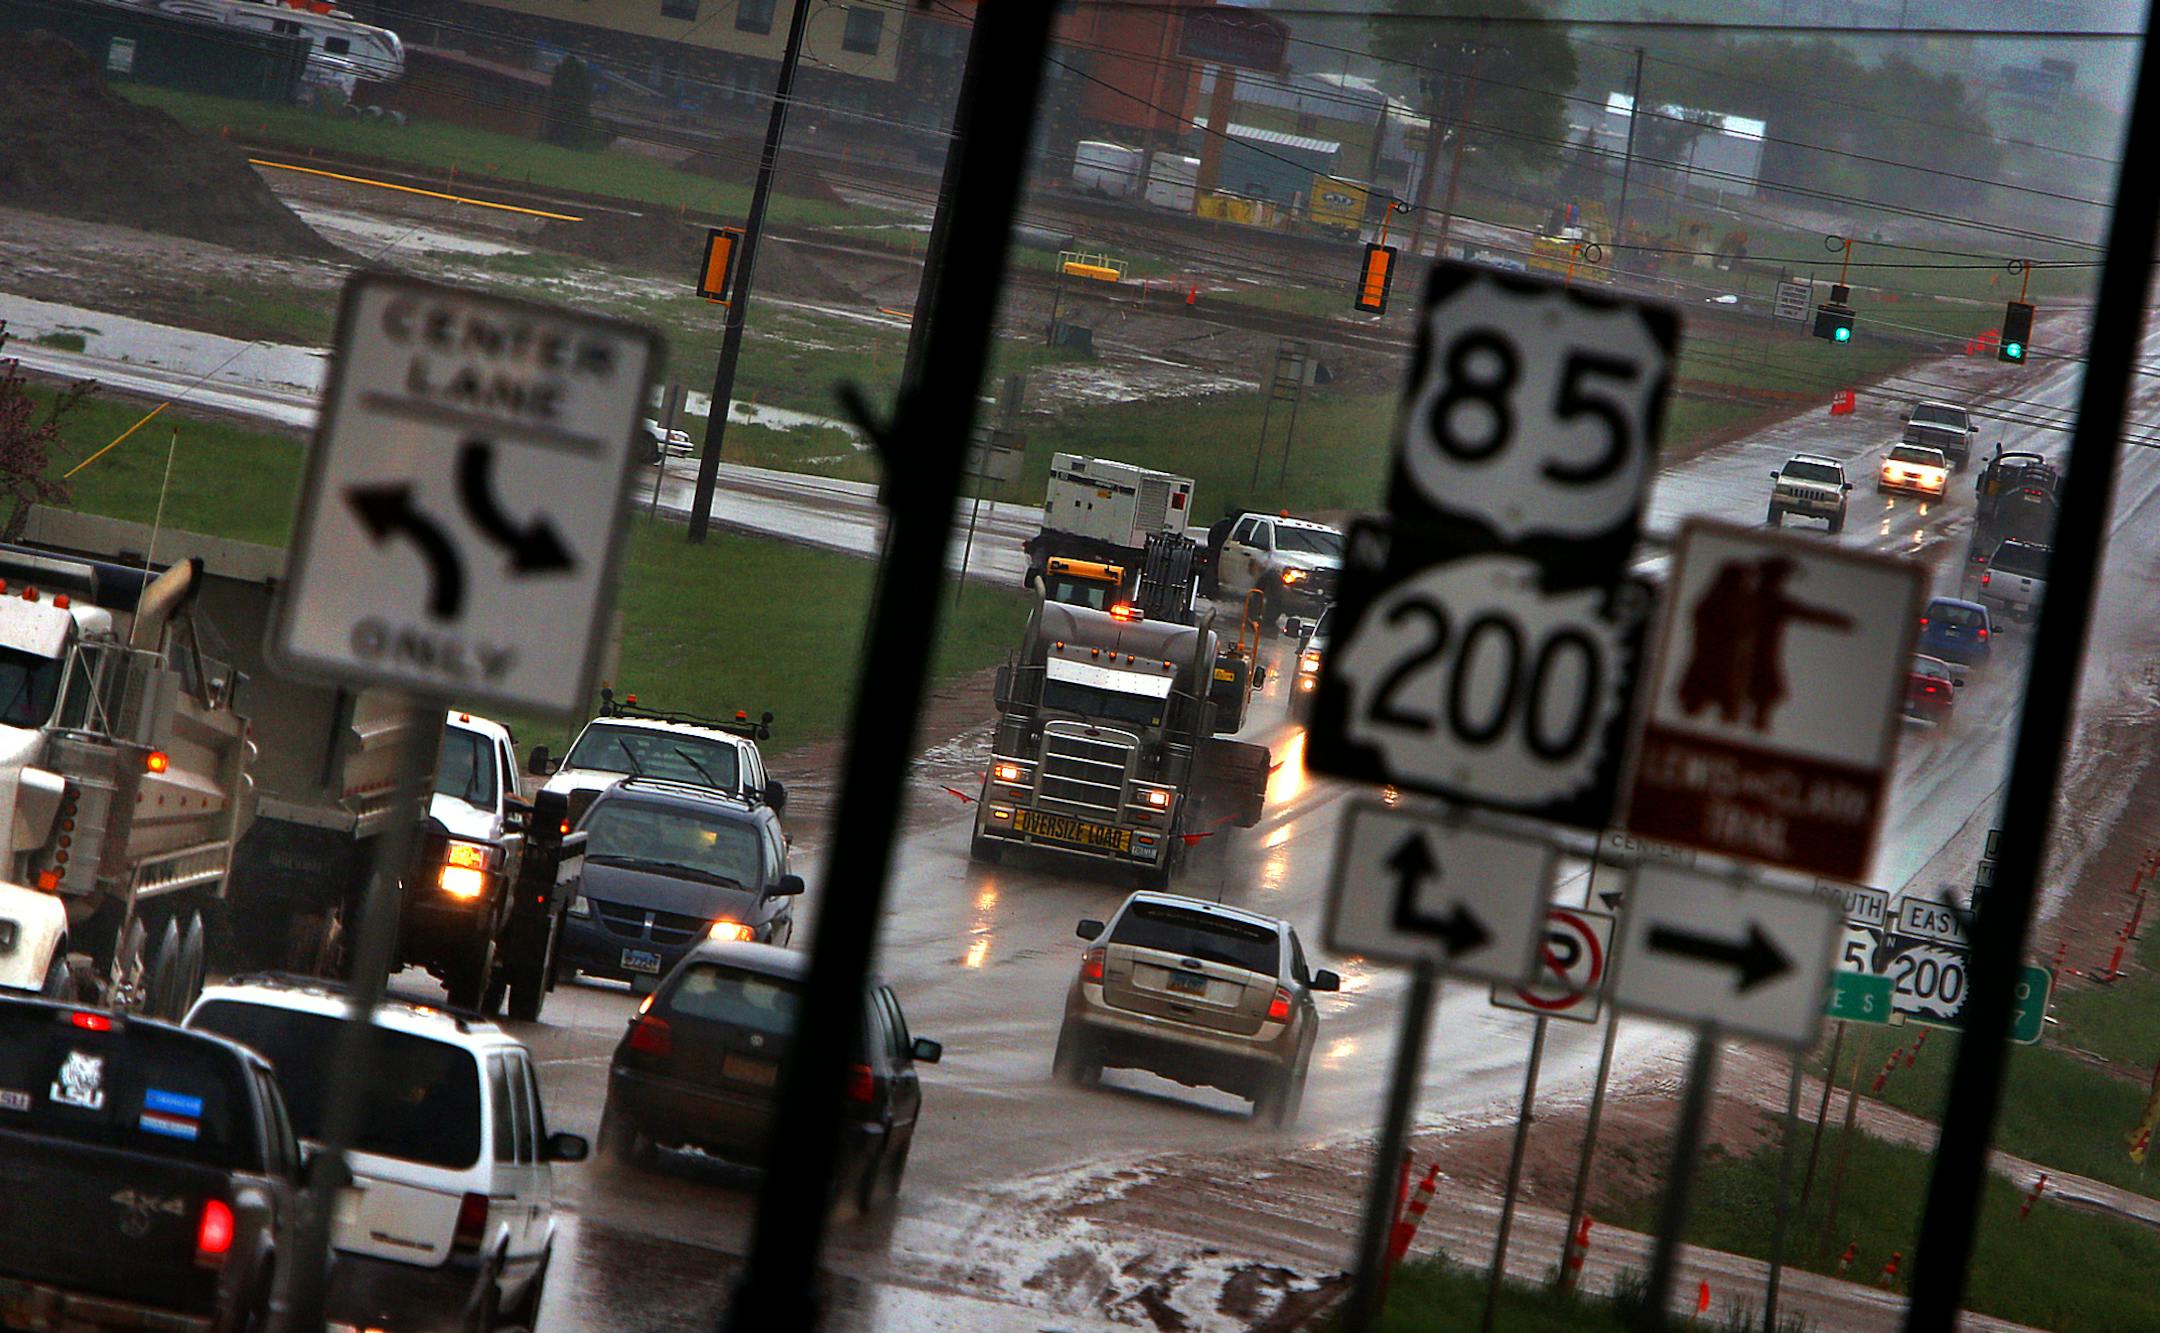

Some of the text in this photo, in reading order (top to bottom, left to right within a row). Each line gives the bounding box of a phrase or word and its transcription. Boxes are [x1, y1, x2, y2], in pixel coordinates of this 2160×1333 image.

[381, 299, 620, 380] CENTER
[407, 353, 566, 419] LANE
[1427, 326, 1642, 488] 85
[350, 615, 521, 682] ONLY
[1367, 592, 1602, 764] 200
[1022, 811, 1123, 849] OVERSIZE LOAD
[1911, 907, 1963, 937] EAST
[1895, 954, 1964, 1004] 200
[50, 1081, 105, 1111] LSU
